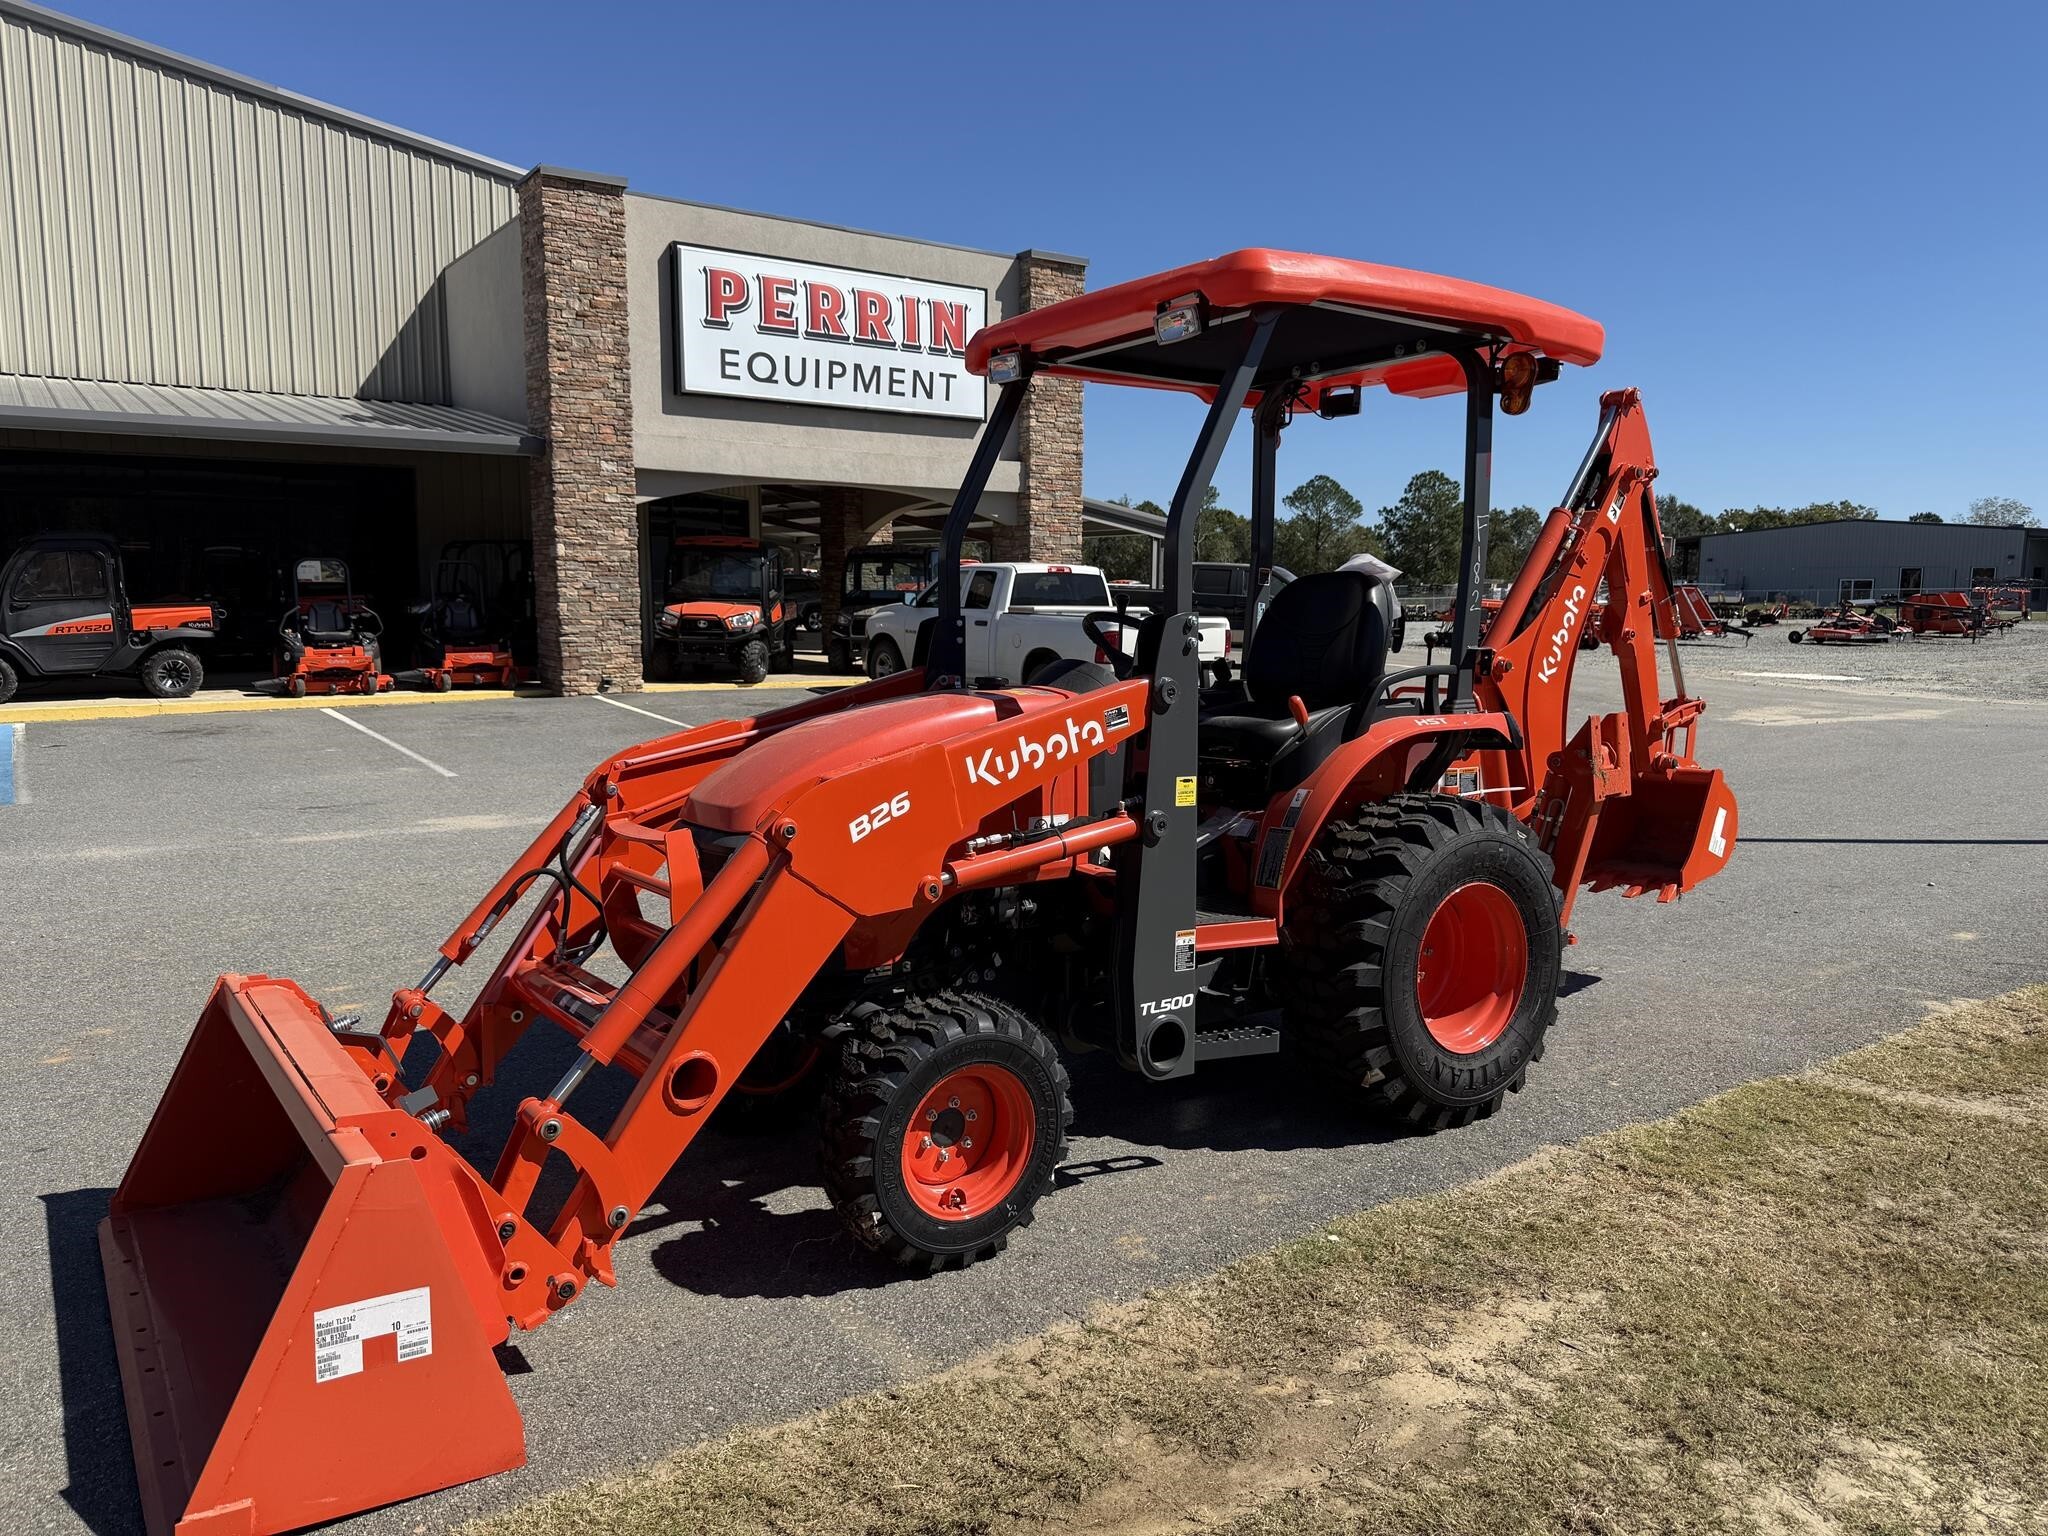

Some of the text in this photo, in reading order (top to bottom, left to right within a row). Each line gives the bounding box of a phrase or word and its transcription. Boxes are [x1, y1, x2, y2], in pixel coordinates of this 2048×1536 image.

[699, 266, 970, 358] PERRIN
[720, 348, 957, 401] EQUIPMENT
[55, 624, 112, 634] RTV520
[1537, 584, 1586, 684] Kubota
[1414, 717, 1448, 727] HST
[965, 717, 1105, 786] Kubota
[849, 791, 911, 843] B26
[1140, 993, 1194, 1017] TL500
[1426, 1055, 1505, 1093] TITAN
[316, 1314, 357, 1330] Model TL2142
[391, 1320, 401, 1332] 10
